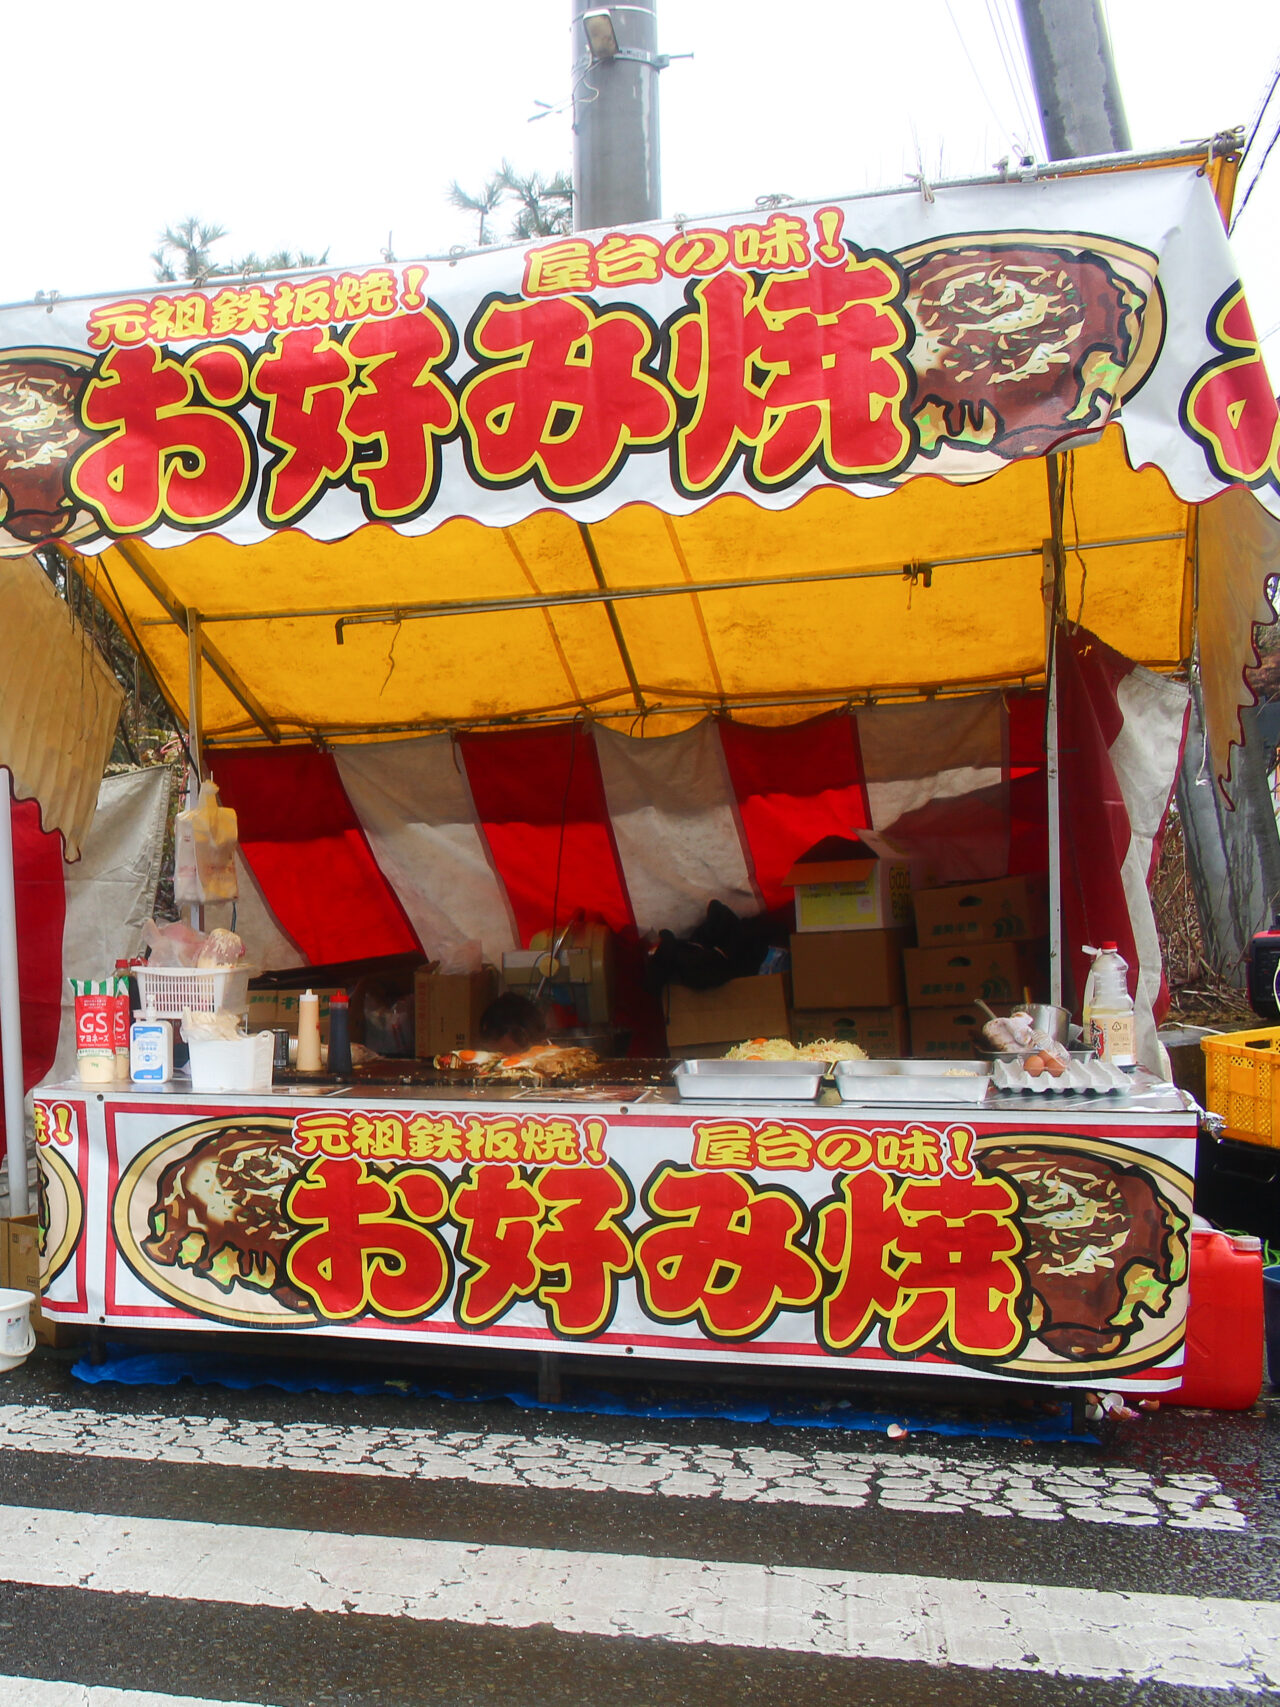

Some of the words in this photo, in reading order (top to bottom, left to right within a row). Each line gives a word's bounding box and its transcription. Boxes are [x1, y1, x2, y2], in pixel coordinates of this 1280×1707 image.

[519, 206, 848, 299] 屋台の味!
[87, 265, 430, 349] 元祖鉄板焼!
[64, 251, 917, 536] お好み焼
[79, 1012, 108, 1033] GS
[79, 1034, 110, 1043] マヨネーズ
[293, 1110, 610, 1168] 元祖鉄板焼!
[691, 1119, 976, 1178] 屋台の味!
[284, 1158, 1030, 1360] お好み焼
